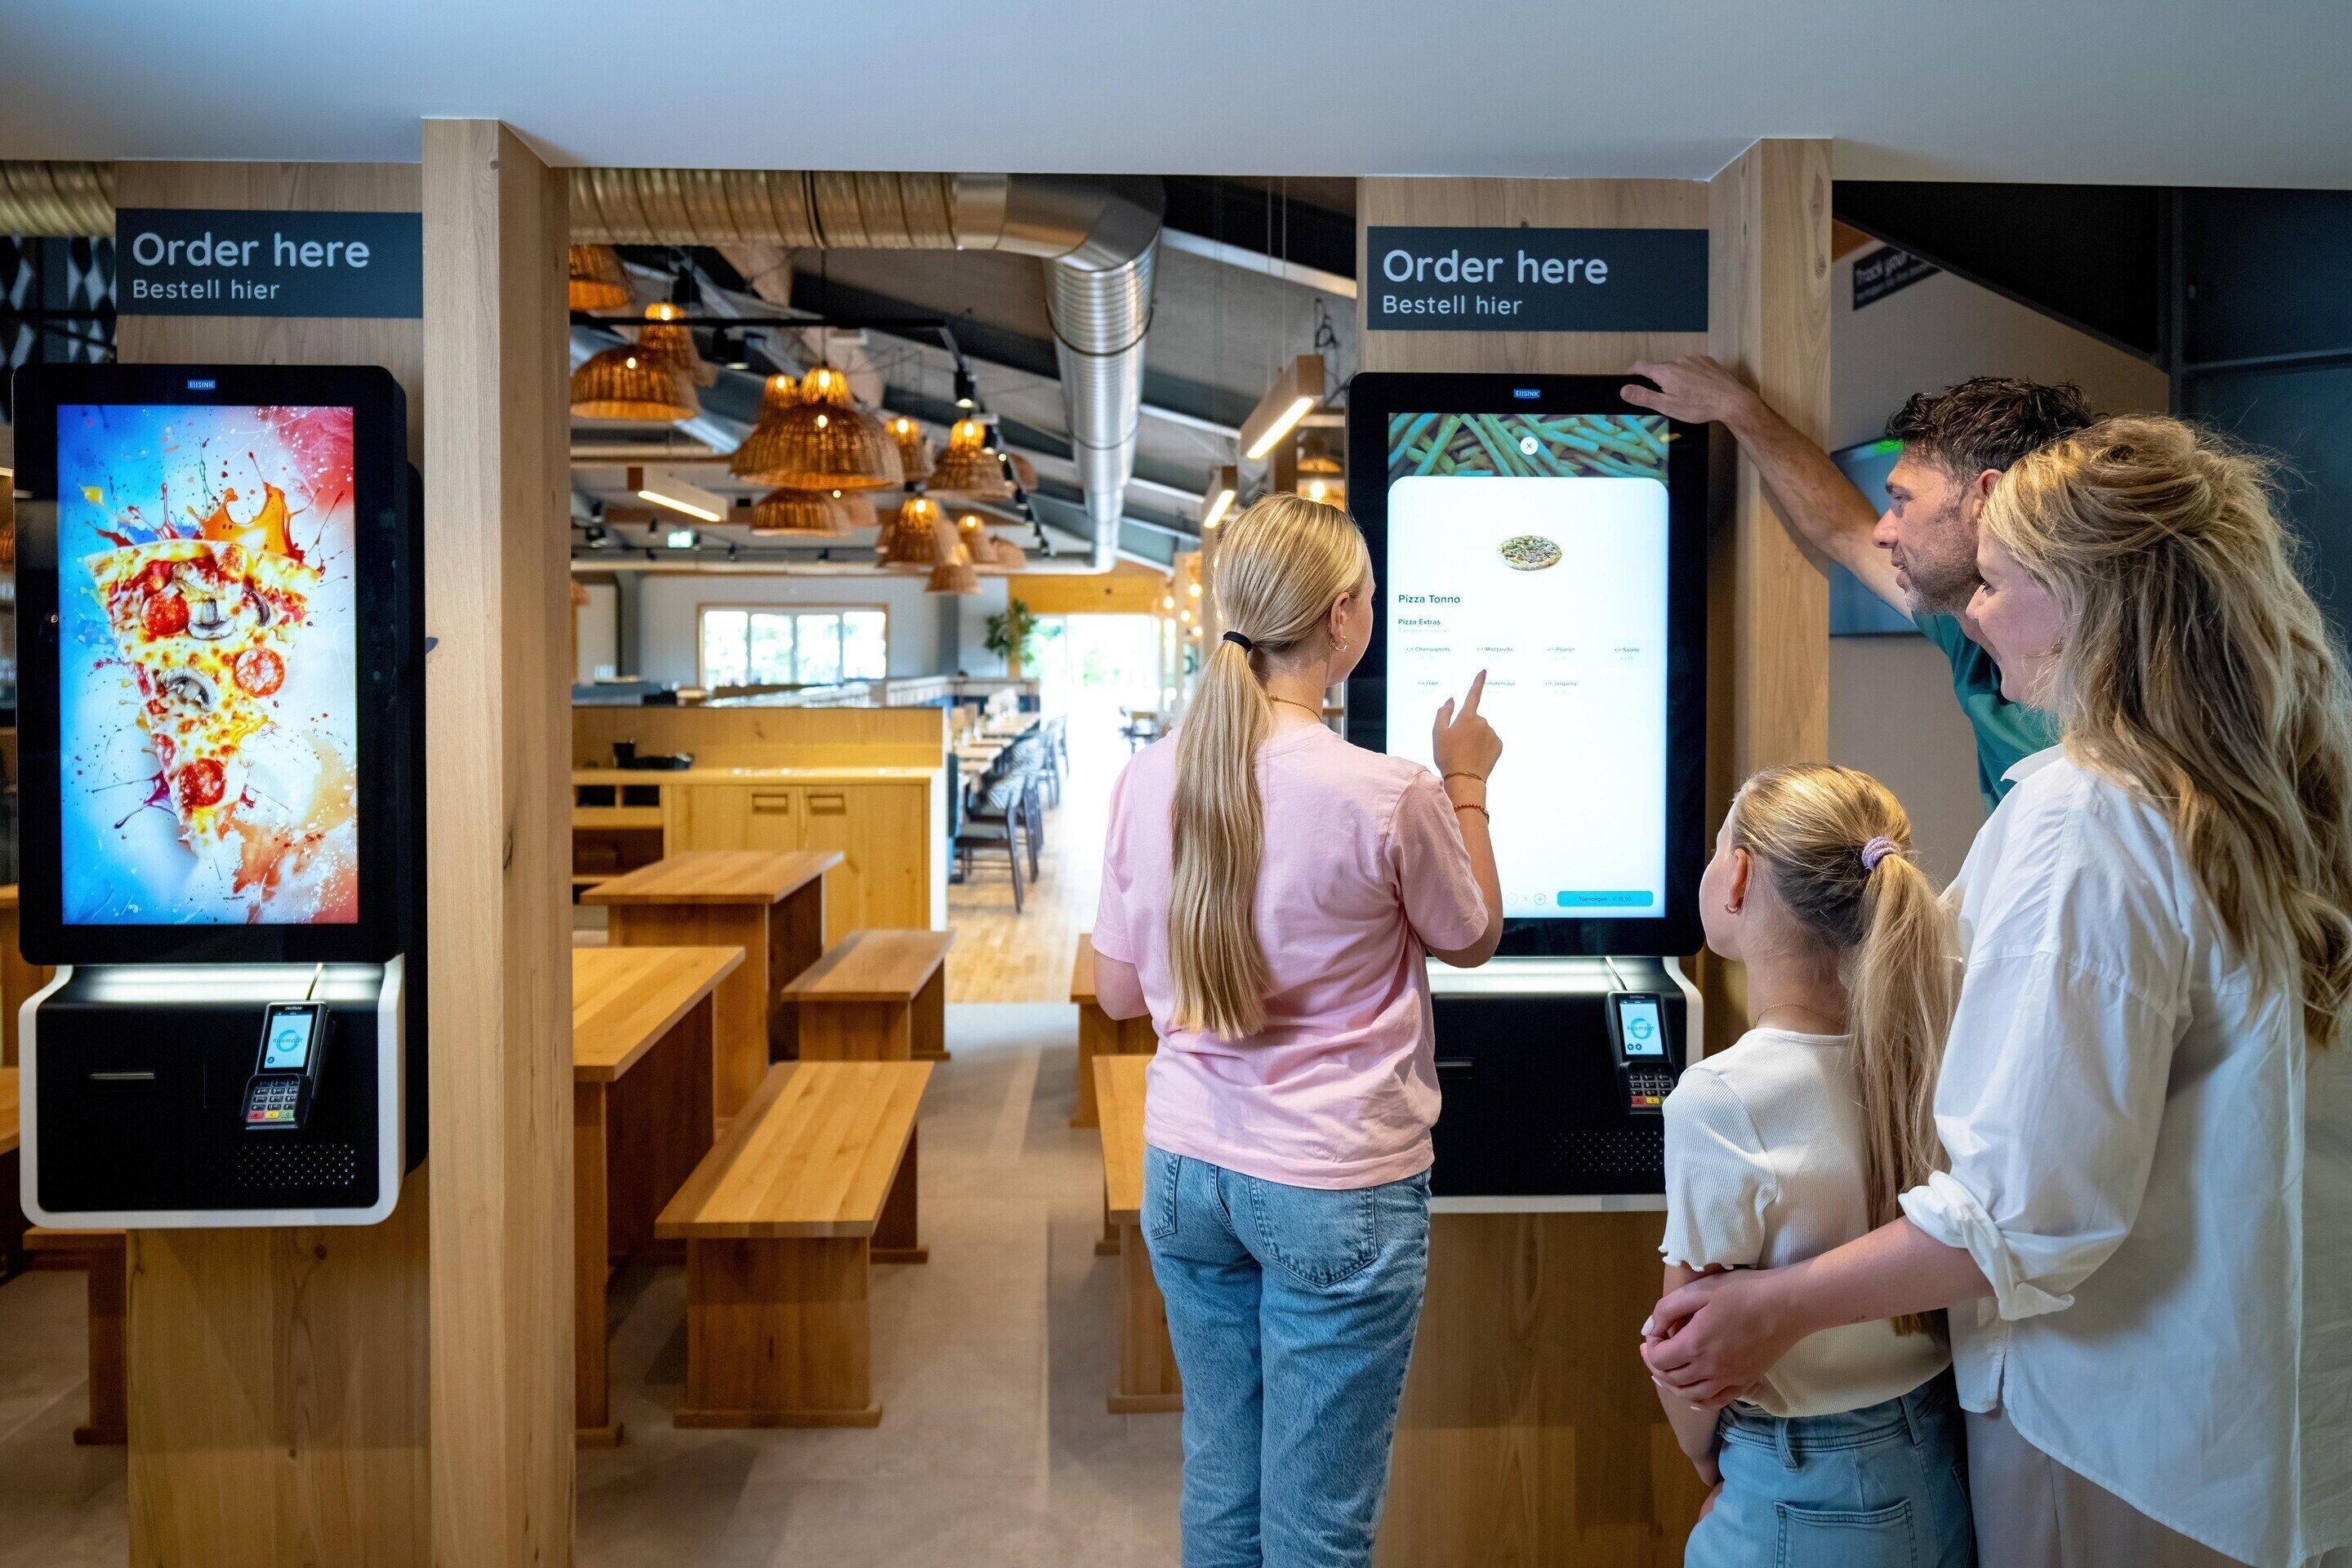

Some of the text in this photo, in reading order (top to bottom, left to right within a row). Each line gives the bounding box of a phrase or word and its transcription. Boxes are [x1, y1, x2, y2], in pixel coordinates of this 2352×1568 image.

[132, 232, 370, 269] Order here
[1383, 248, 1608, 284] Order here
[132, 279, 280, 300] Bestell hier
[1383, 295, 1523, 315] Bestell hier
[1397, 594, 1461, 604] Pizza Tonno
